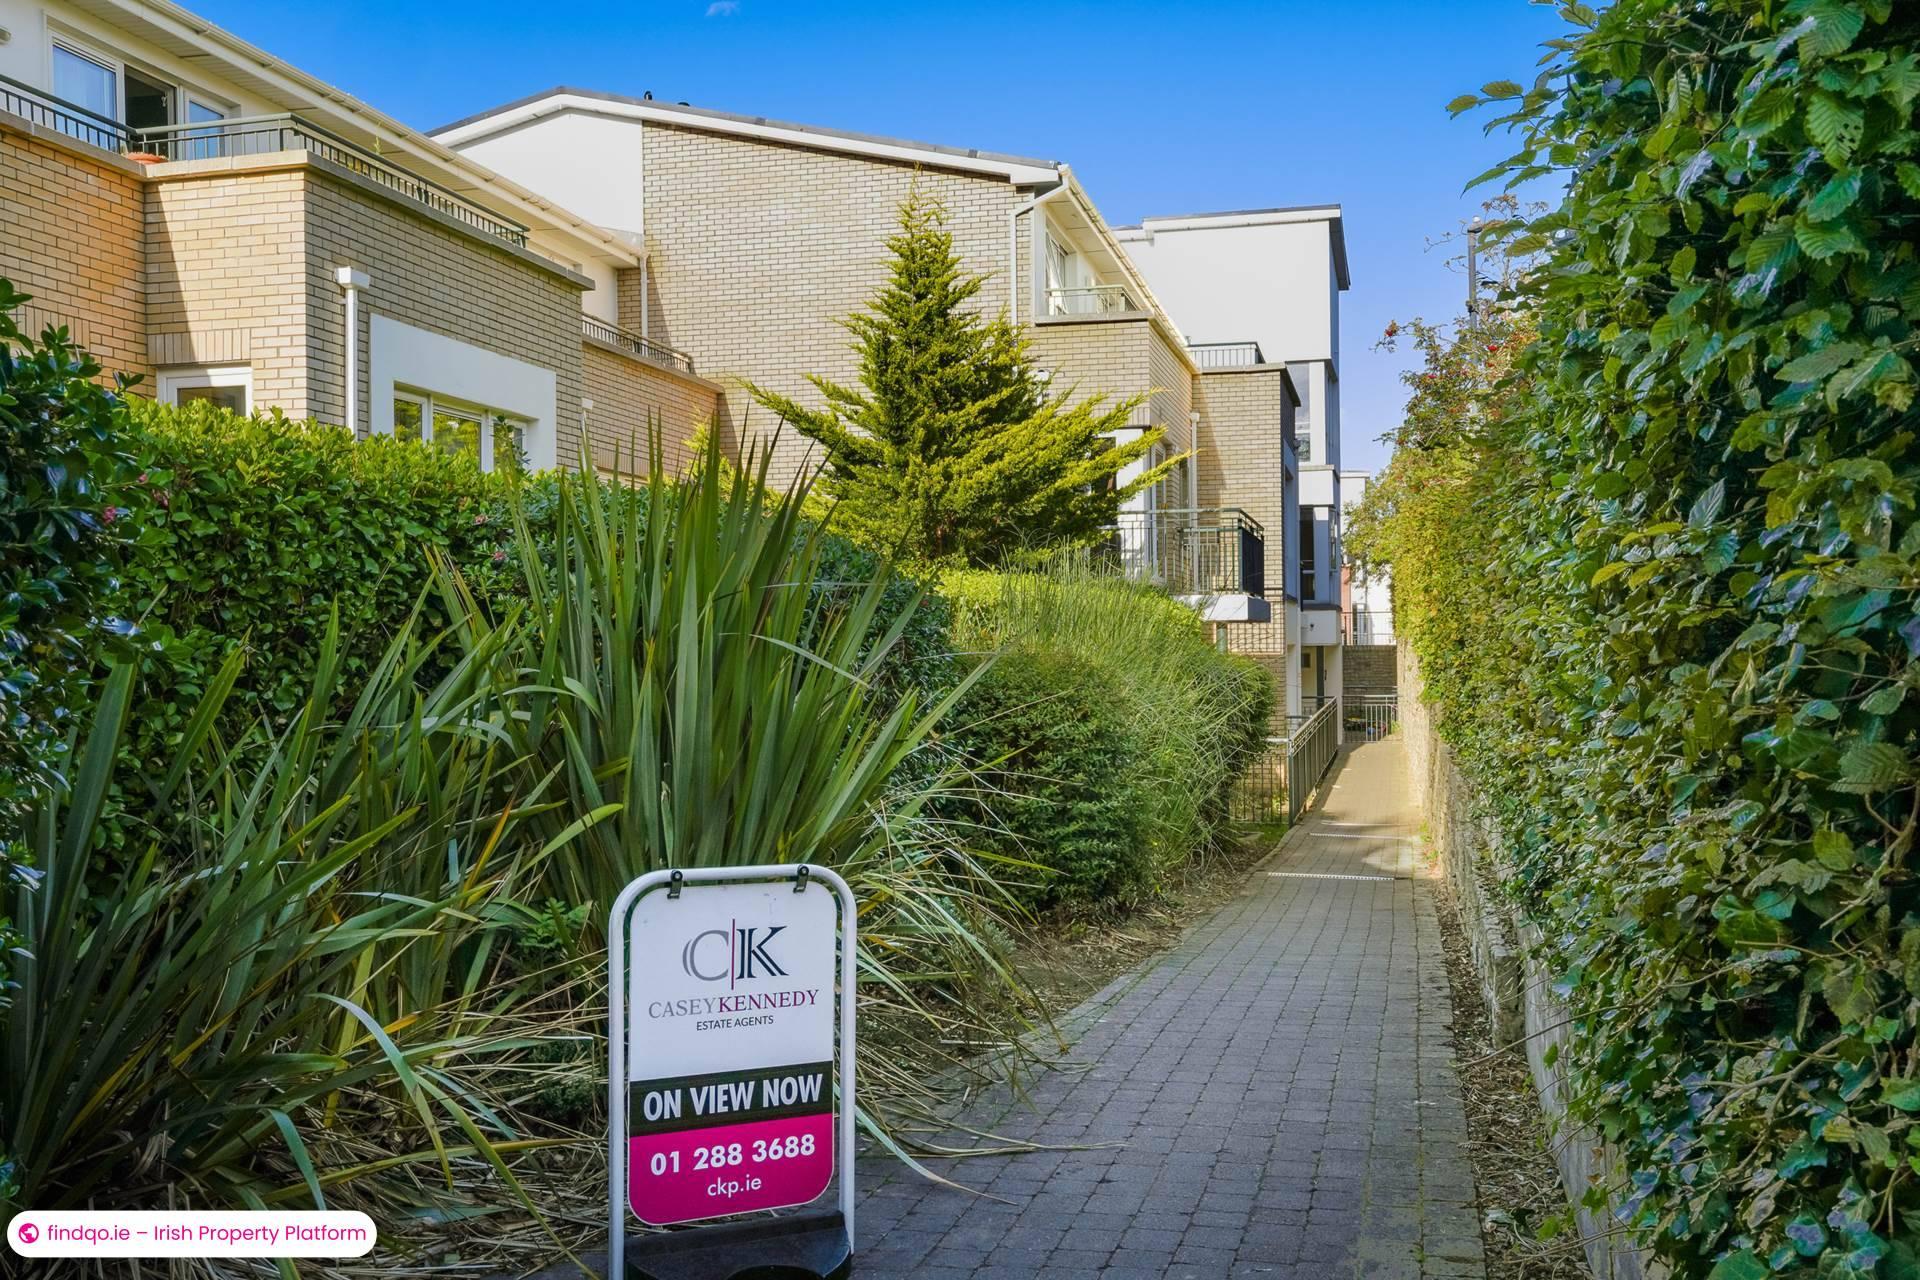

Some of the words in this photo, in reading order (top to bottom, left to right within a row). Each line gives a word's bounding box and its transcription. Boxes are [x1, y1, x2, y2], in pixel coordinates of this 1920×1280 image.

[696, 1018, 733, 1031] ESTATE
[734, 1015, 774, 1027] AGENTS
[643, 1089, 682, 1121] ON
[690, 1081, 755, 1116] VIEW
[762, 1073, 824, 1108] NOW
[650, 1151, 681, 1176] 01
[692, 1143, 743, 1171] 288
[752, 1134, 816, 1163] 3688
[707, 1174, 762, 1198] ckp.ie
